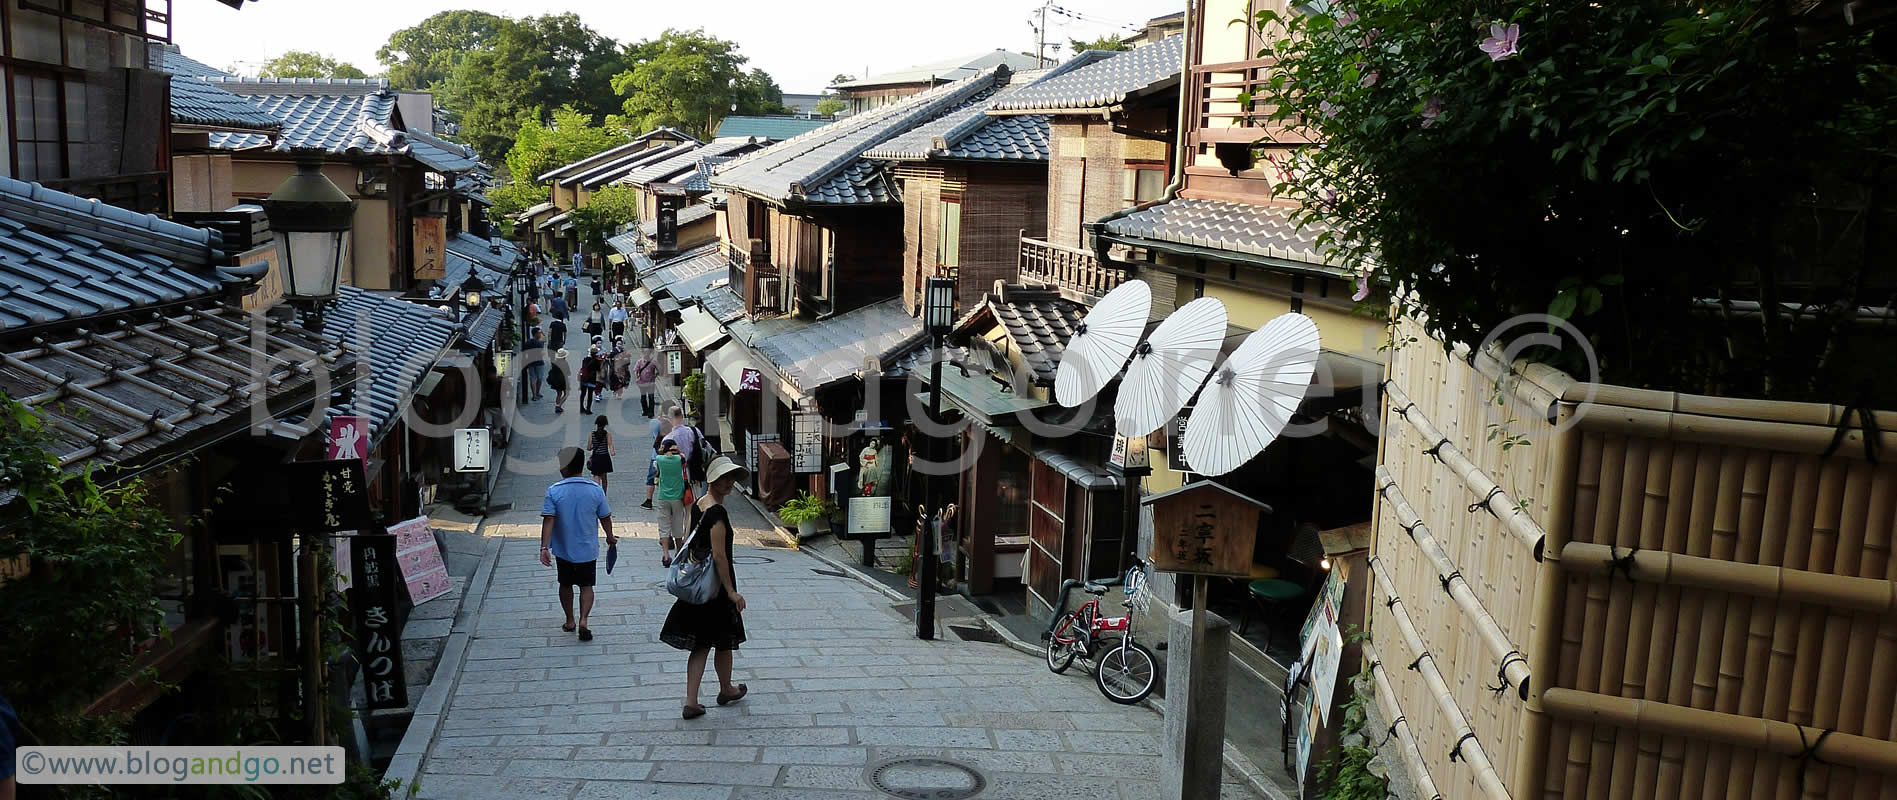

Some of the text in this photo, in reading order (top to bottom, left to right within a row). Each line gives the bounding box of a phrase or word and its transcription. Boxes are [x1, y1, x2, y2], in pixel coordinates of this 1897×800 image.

[335, 423, 360, 460] 氷
[365, 606, 396, 702] きんつば
